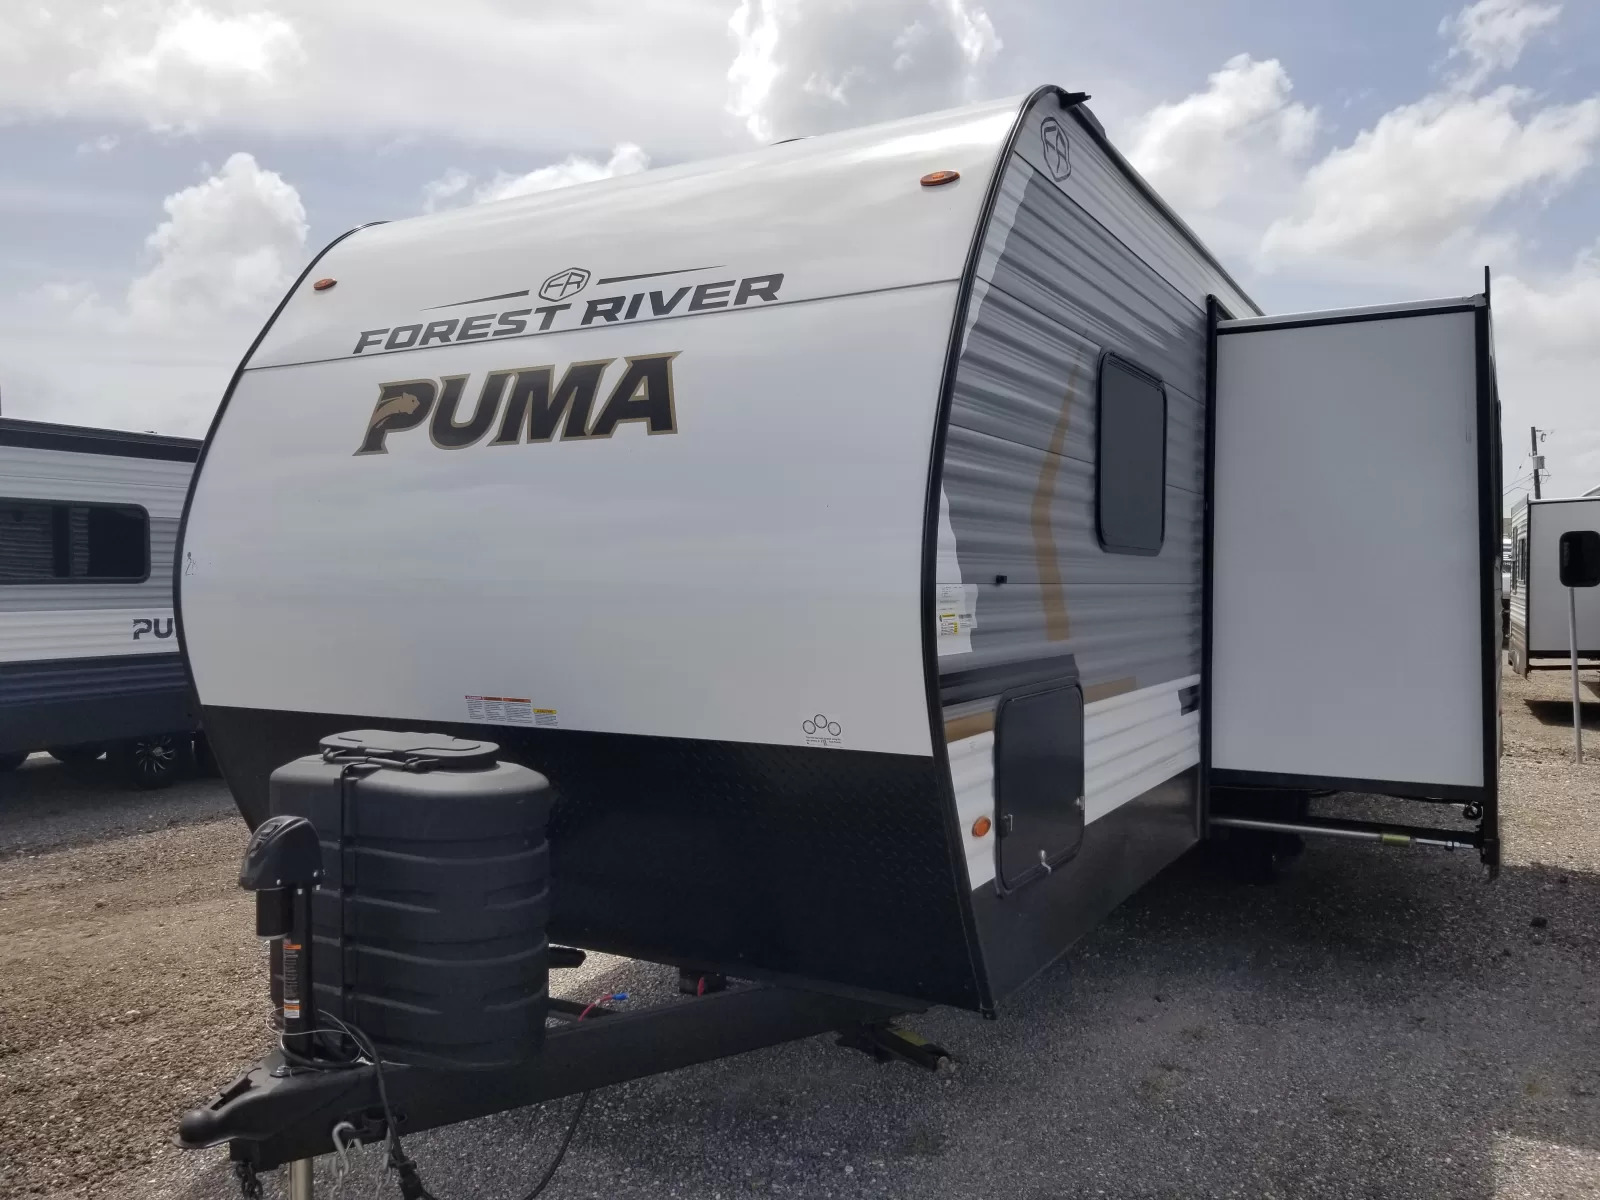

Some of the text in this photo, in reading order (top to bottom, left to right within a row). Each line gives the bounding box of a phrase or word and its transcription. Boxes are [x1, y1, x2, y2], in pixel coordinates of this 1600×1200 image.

[353, 273, 785, 354] FOREST RIVER
[352, 351, 684, 456] PUMA
[132, 617, 174, 640] PU
